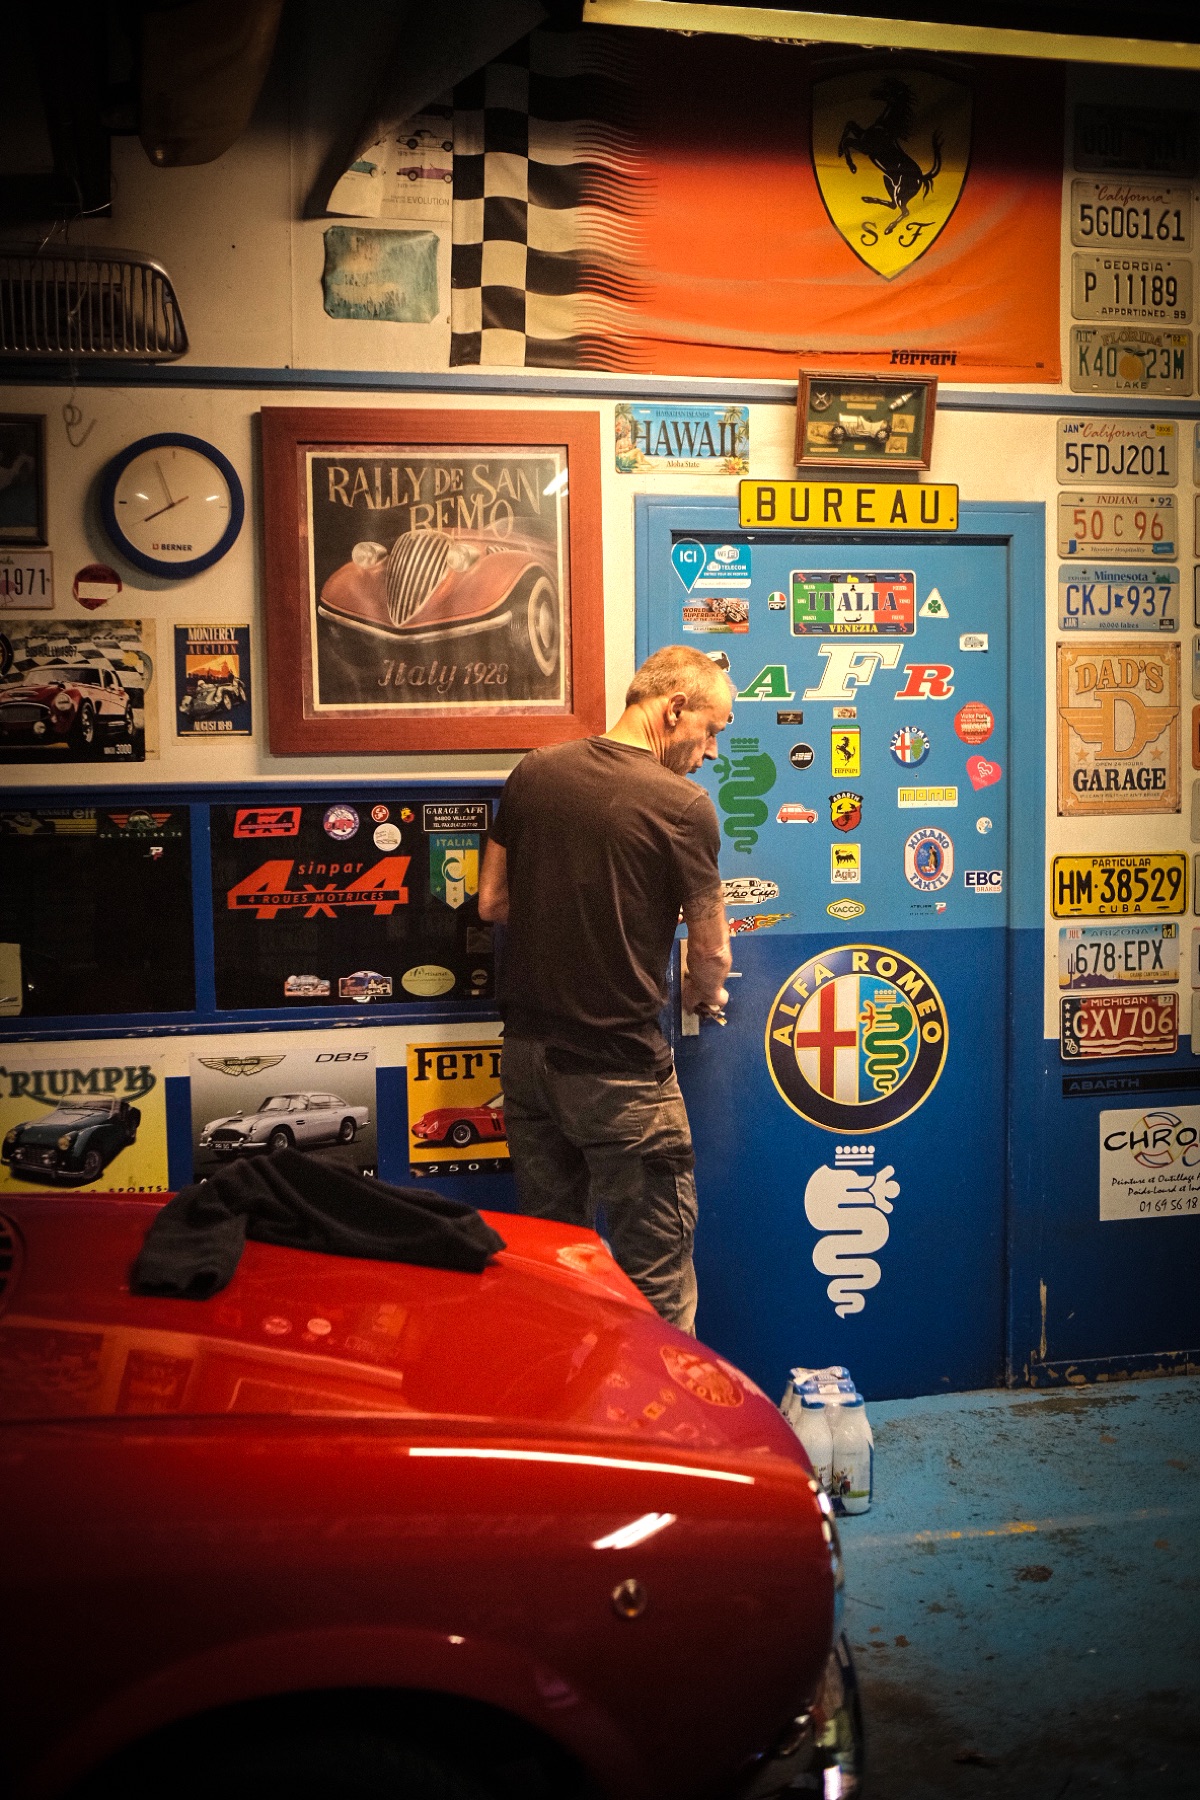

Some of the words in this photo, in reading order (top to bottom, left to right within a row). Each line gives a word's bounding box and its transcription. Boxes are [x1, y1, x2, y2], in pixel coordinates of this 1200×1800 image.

[407, 196, 450, 207] EVOLUTION
[1098, 185, 1171, 206] California
[860, 222, 879, 246] S
[898, 222, 935, 247] F
[1103, 260, 1164, 273] GEORGIA
[1084, 271, 1097, 303] P
[1113, 273, 1178, 307] 11189
[1101, 307, 1166, 318] APPORTIONED
[1173, 309, 1187, 319] 99
[1101, 329, 1164, 347] FLORIDA
[1115, 381, 1148, 390] LAKE
[656, 410, 685, 418] HAWAIIAN
[686, 411, 710, 419] ISLANDS
[631, 420, 738, 458] HAWAII
[1063, 424, 1079, 433] JAN
[1083, 423, 1155, 442] California
[1065, 443, 1170, 475] 5FDJ201
[327, 466, 431, 510] RALLY
[433, 468, 464, 496] DE
[472, 464, 541, 514] SAN
[756, 487, 940, 524] BUREAU
[1096, 496, 1139, 505] INDIANA
[1157, 498, 1172, 507] 92
[1074, 509, 1104, 540] 50
[1113, 514, 1123, 537] C
[1134, 511, 1164, 541] 96
[679, 550, 697, 563] ICI
[1094, 571, 1149, 582] Minnesota
[808, 592, 899, 611] ITALIA
[829, 624, 878, 633] VENEZIA
[1065, 618, 1077, 627] JAN
[188, 628, 236, 641] MONTEREY
[189, 644, 237, 654] AUCTION
[378, 659, 457, 693] Italy
[1075, 659, 1164, 695] DAD'S
[194, 721, 216, 730] AUGUST
[116, 744, 132, 755] 3000
[1073, 768, 1166, 791] GARAGE
[833, 791, 860, 802] ABARTH
[73, 808, 96, 818] elf
[426, 807, 460, 815] GARAGE
[463, 806, 484, 814] AFR
[436, 839, 473, 847] ITALIA
[298, 861, 363, 877] sinpar
[1092, 858, 1151, 868] PARTICULAR
[834, 870, 857, 881] Agip
[909, 873, 949, 891] TAHITI
[965, 871, 1001, 886] EBC
[262, 894, 308, 904] ROUES
[315, 892, 384, 902] MOTRICES
[750, 889, 776, 897] Cup
[1099, 904, 1141, 913] CUBA
[1068, 930, 1080, 939] JUL
[1091, 927, 1149, 937] ARIZONA
[1163, 929, 1172, 938] 02
[773, 962, 835, 1047] ALFA
[852, 951, 942, 1044] ROMEO
[1091, 996, 1148, 1007] MICHIGAN
[1073, 1006, 1174, 1039] GXV706
[315, 1052, 369, 1063] DB5
[1069, 1078, 1140, 1091] ABARTH
[1104, 1127, 1200, 1151] CHRO
[1112, 1178, 1145, 1187] Peinture
[1148, 1176, 1155, 1184] et
[1158, 1174, 1195, 1185] Outillage
[1179, 1185, 1187, 1193] et
[1154, 1199, 1168, 1212] 69
[1171, 1198, 1183, 1210] 56
[1186, 1197, 1198, 1210] 18
